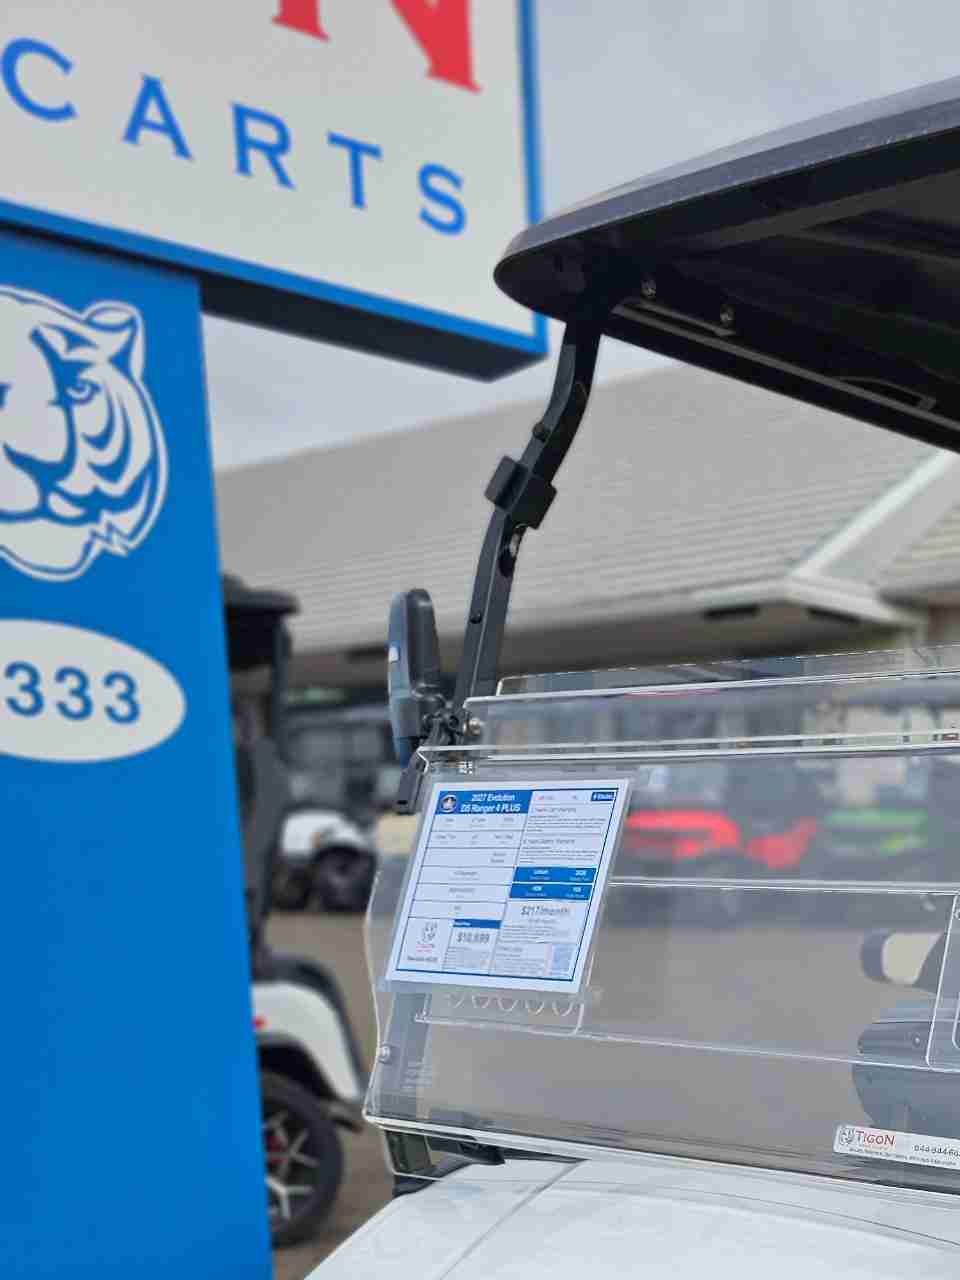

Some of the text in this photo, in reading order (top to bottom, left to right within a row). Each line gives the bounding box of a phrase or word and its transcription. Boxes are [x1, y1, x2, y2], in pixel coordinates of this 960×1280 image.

[0, 37, 469, 236] CARTS
[4, 660, 141, 726] 333
[502, 803, 521, 812] PLUS
[855, 1130, 896, 1147] TIGON
